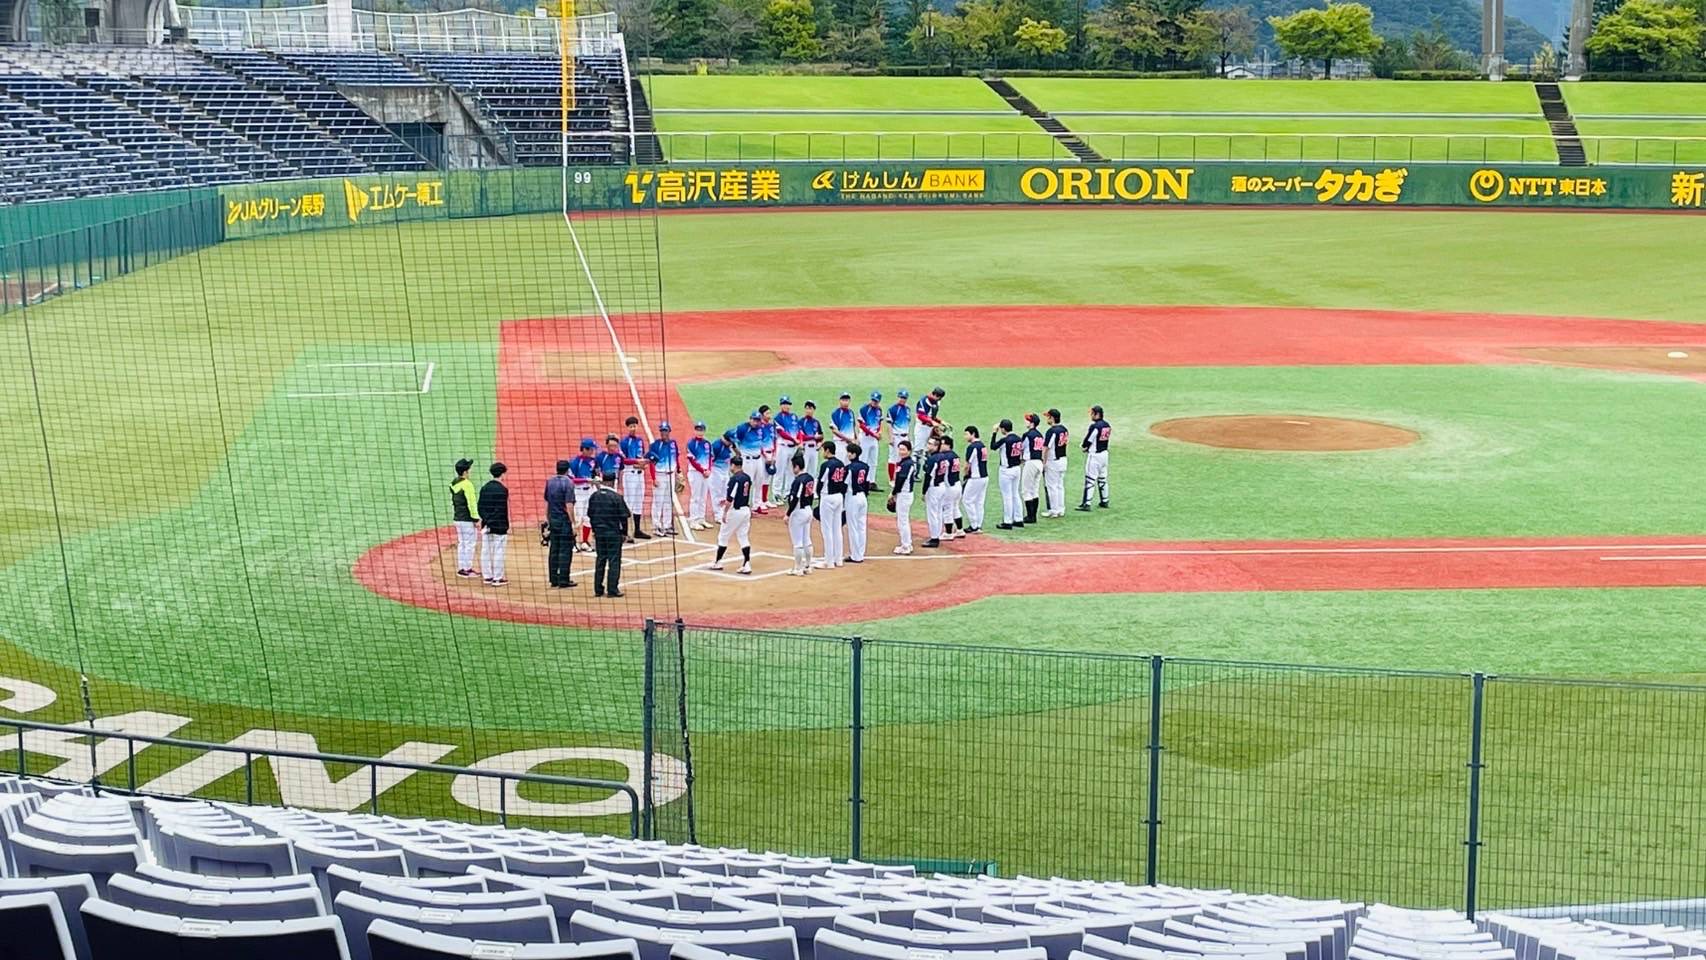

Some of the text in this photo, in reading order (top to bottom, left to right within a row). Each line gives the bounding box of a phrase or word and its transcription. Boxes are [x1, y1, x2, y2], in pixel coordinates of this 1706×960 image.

[574, 171, 592, 184] 99
[656, 170, 780, 202] 高沢産業
[842, 171, 979, 189] けんしん BANK
[1020, 168, 1194, 200] ORION
